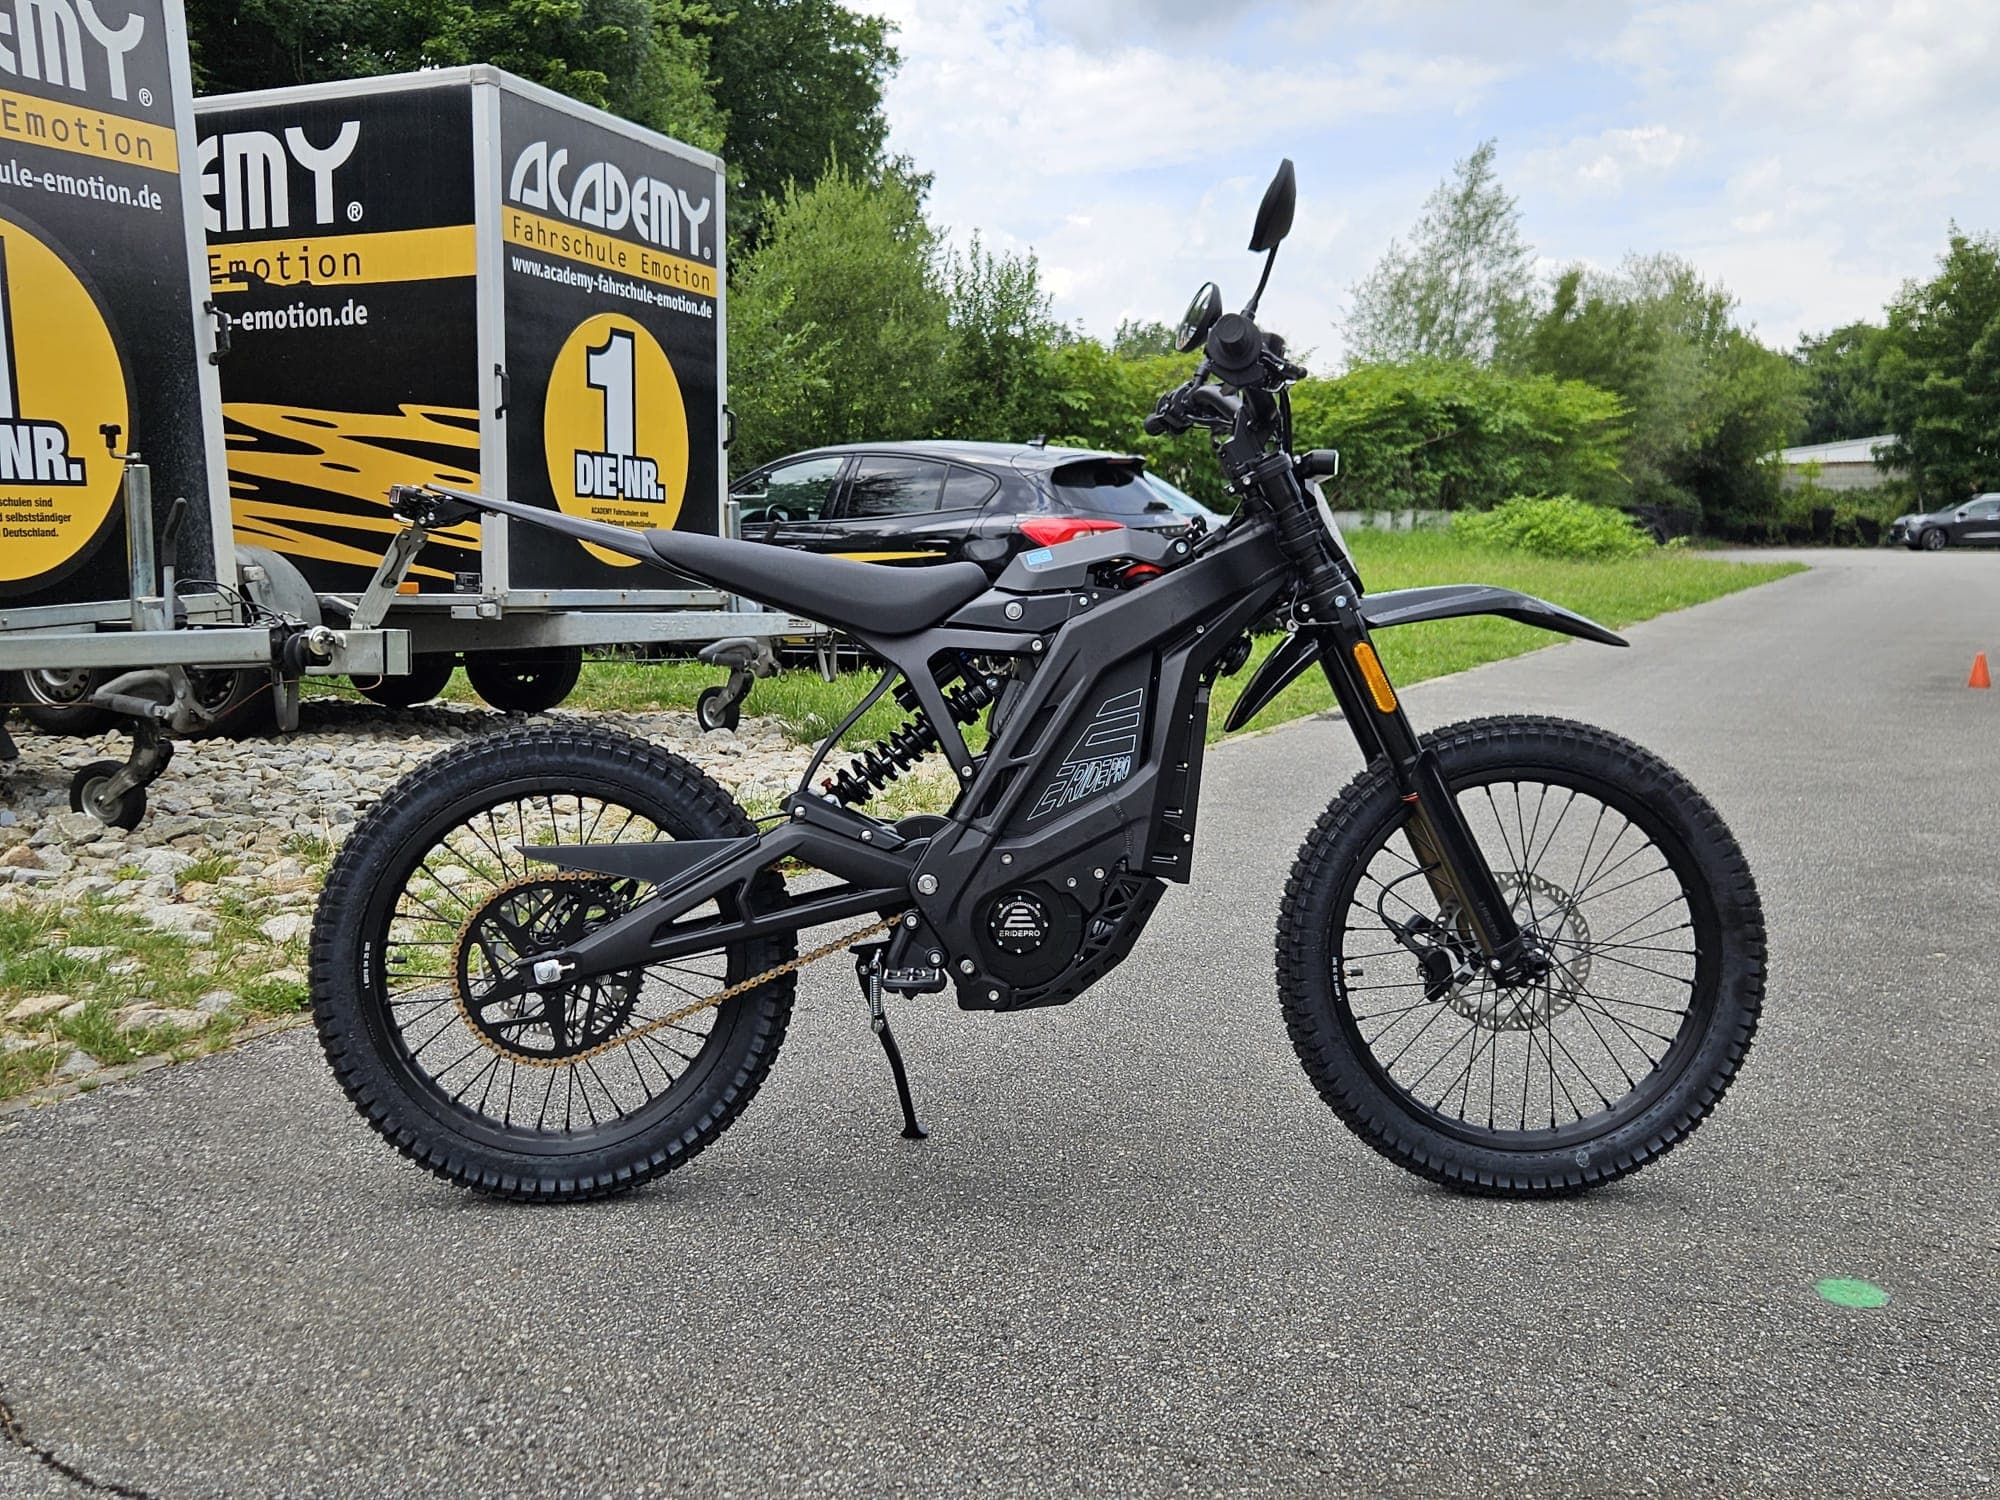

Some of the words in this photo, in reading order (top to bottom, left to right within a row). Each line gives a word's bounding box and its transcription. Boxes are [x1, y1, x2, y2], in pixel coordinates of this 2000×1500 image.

[2, 98, 153, 161] Emotion
[509, 141, 711, 256] ACADEMY
[207, 246, 361, 285] Emotion
[513, 215, 627, 268] Fahrschule
[641, 252, 711, 291] Emotion
[511, 255, 713, 318] www.academy-fahrschule-emotion.de
[586, 327, 636, 488] 1
[34, 497, 53, 507] sind
[575, 451, 618, 498] DIE
[622, 456, 665, 502] NR.
[2, 528, 59, 538] Deutschland.
[5, 513, 72, 524] selbstständiger
